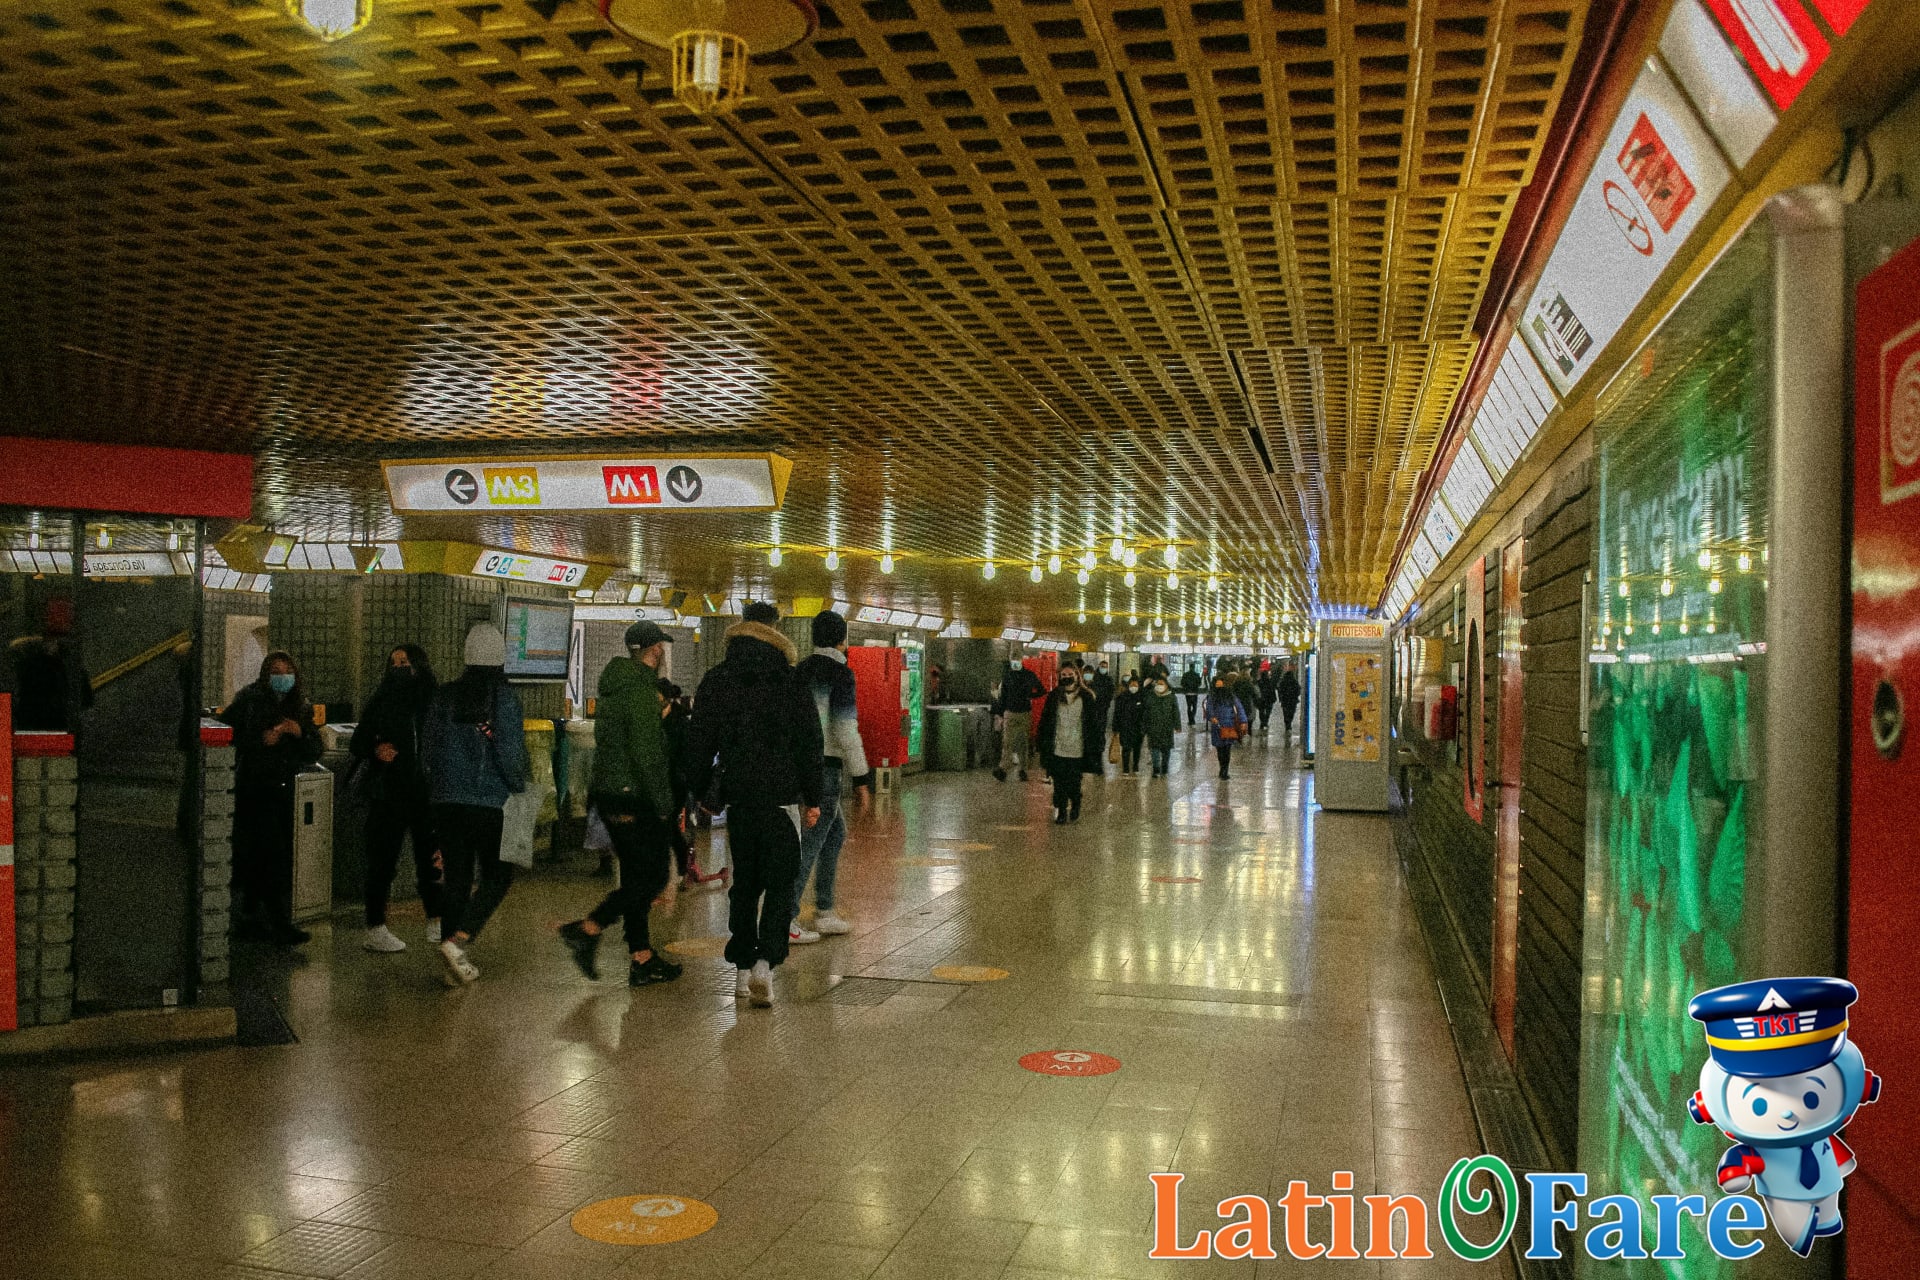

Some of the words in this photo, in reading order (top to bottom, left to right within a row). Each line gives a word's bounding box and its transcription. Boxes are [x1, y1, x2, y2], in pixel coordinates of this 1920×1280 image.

[492, 475, 535, 498] M3
[611, 474, 652, 497] M1
[1332, 626, 1381, 637] FOTOTESSERA
[1335, 711, 1345, 745] FOTO
